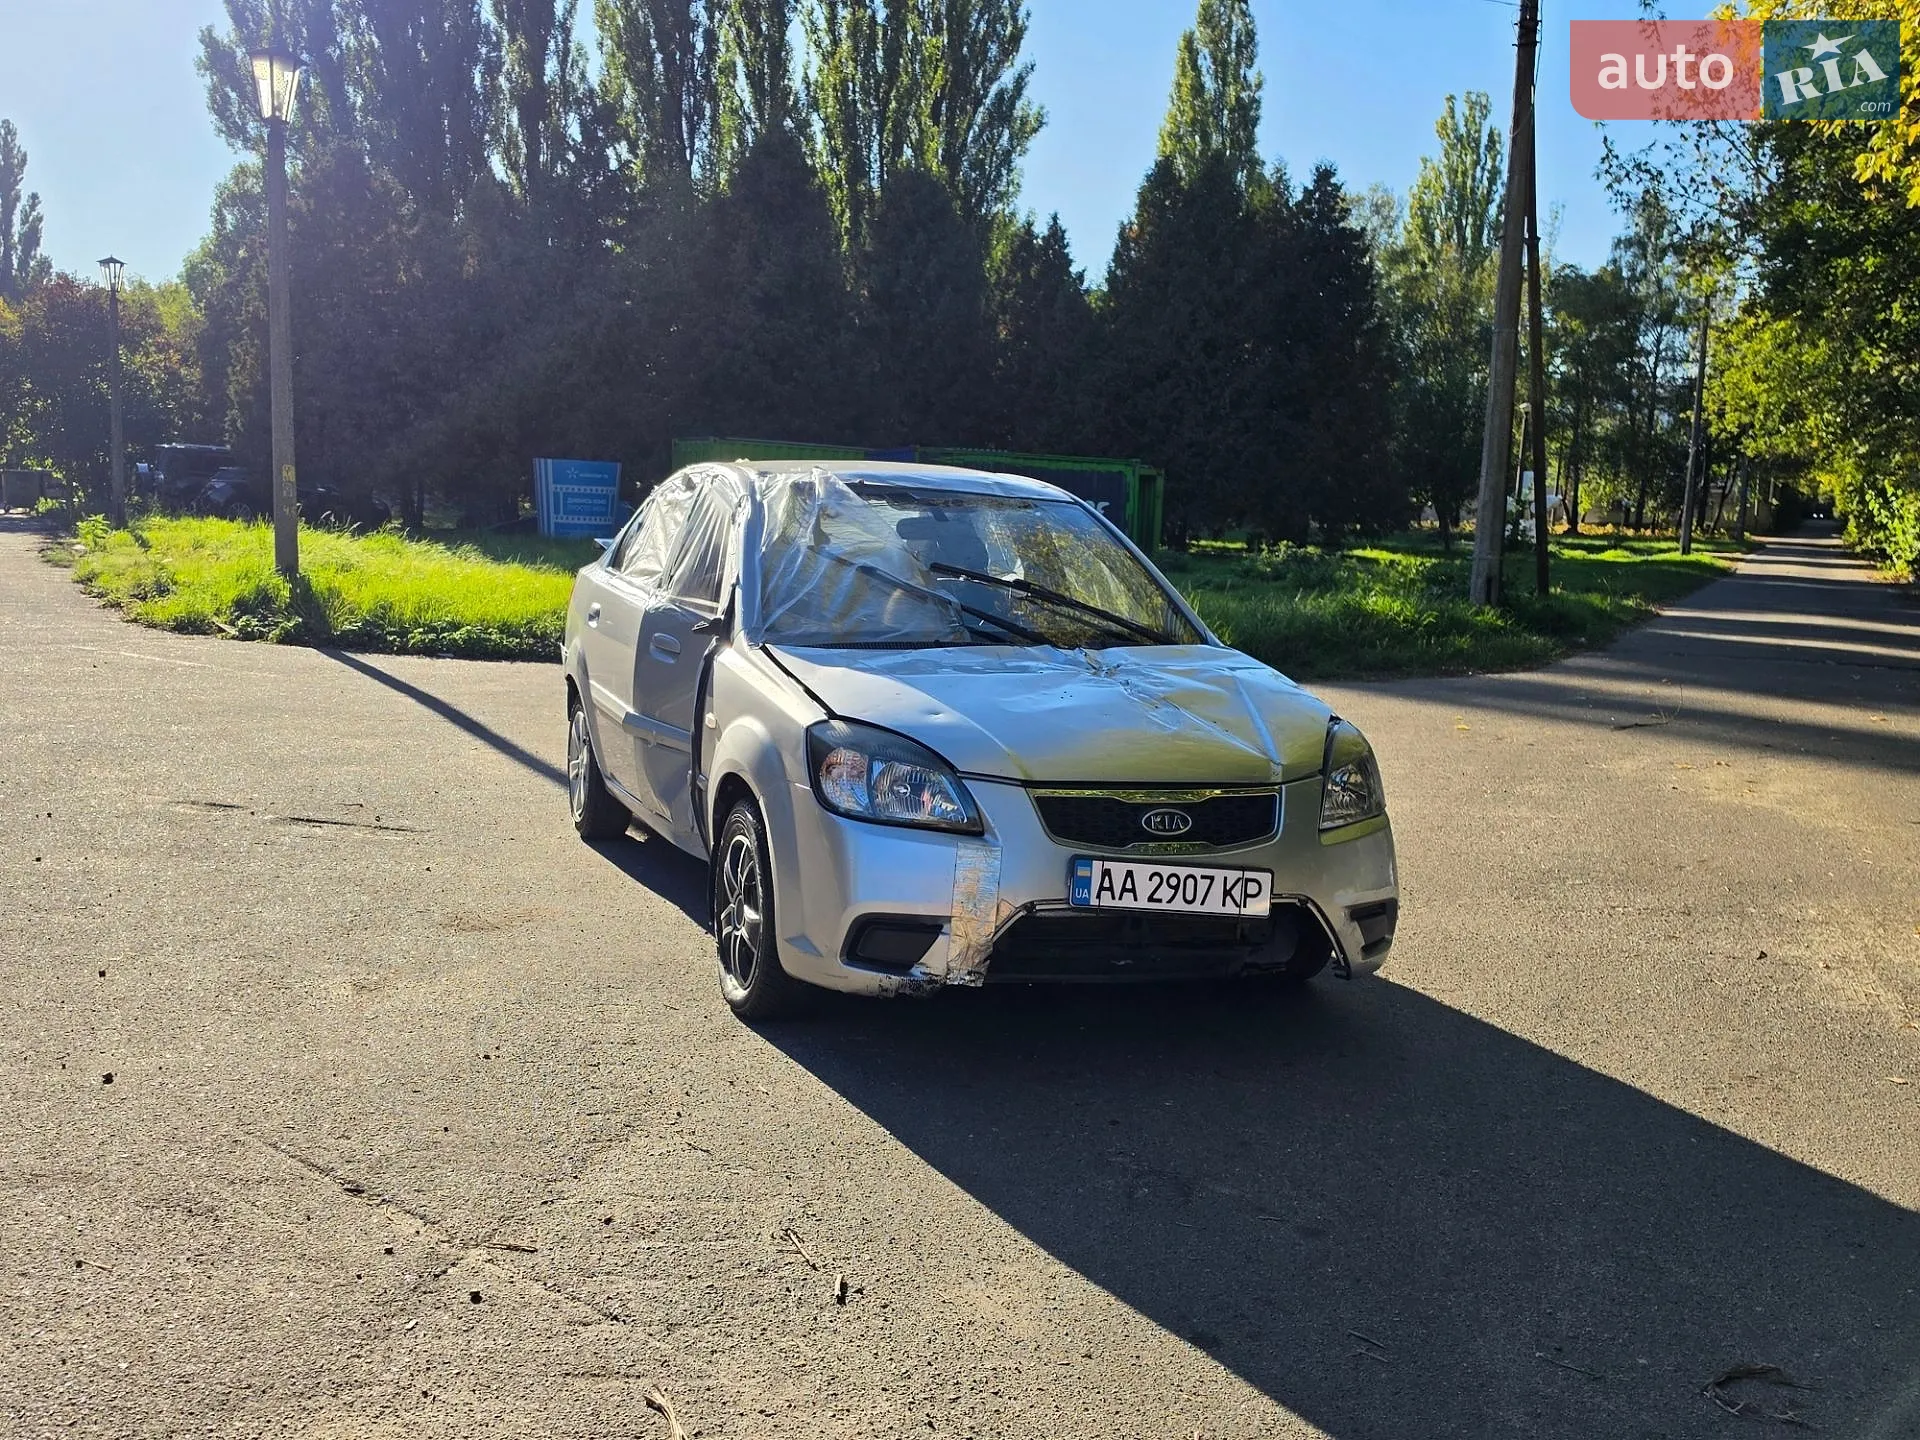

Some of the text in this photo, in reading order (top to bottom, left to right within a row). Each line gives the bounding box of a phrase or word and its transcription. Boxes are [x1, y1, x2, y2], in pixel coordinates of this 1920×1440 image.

[1150, 815, 1186, 830] KIA
[1075, 887, 1089, 899] UA
[1096, 868, 1262, 909] AA 2907 KP
